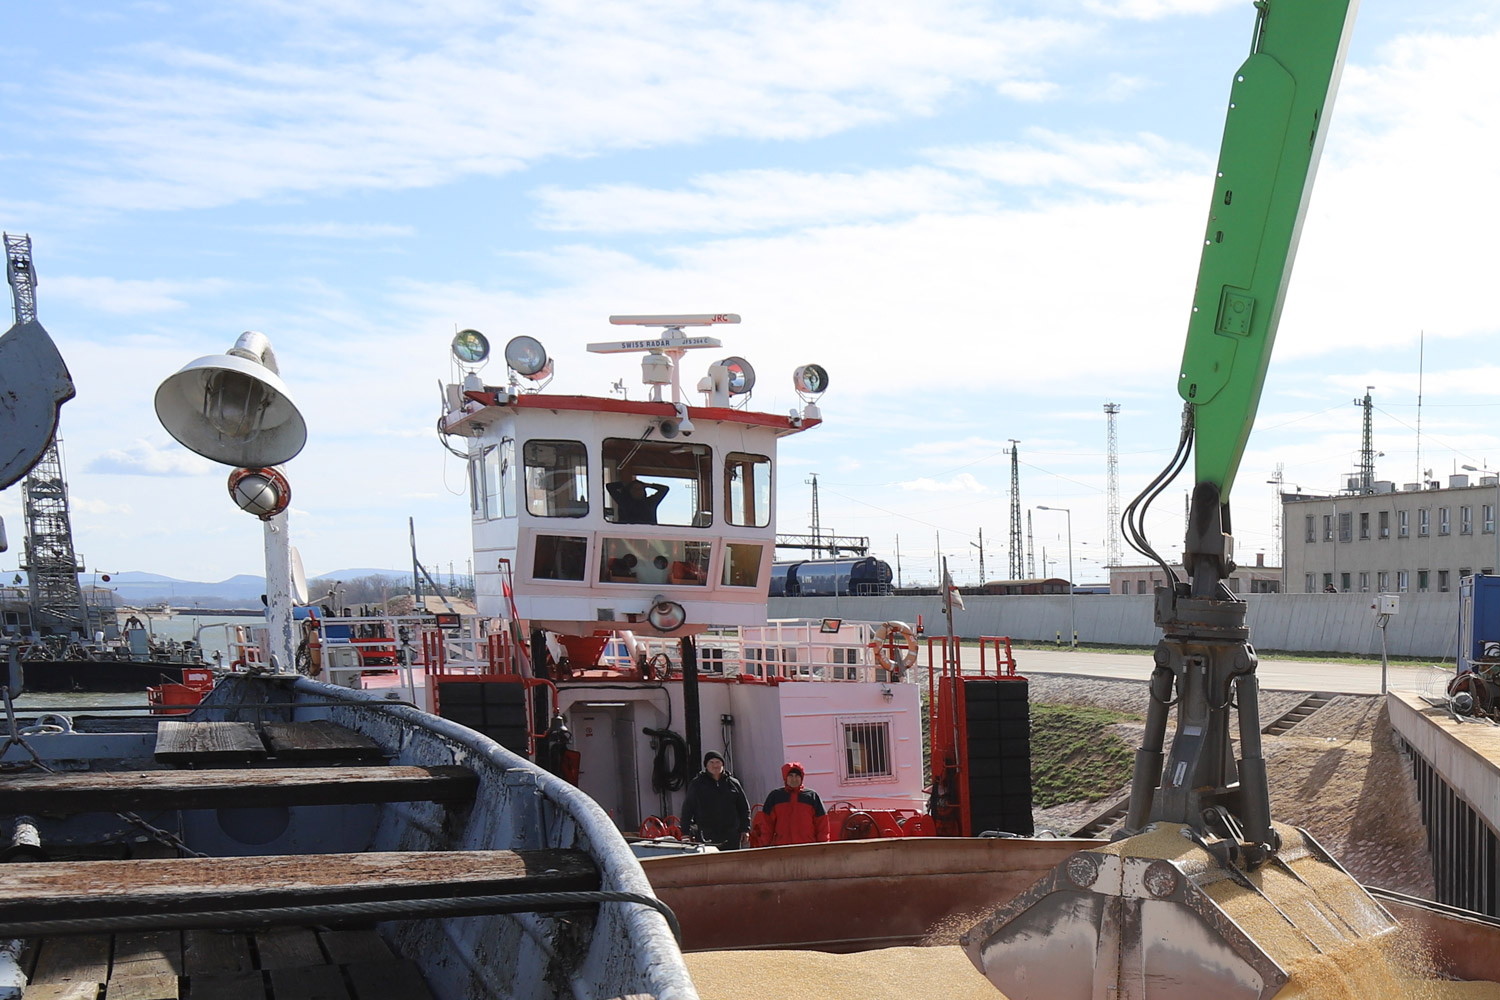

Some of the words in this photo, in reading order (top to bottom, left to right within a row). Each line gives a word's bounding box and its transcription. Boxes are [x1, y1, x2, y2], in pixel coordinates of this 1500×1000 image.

[711, 314, 728, 322] JRC
[621, 341, 644, 349] SWISS
[646, 340, 671, 348] RADAR
